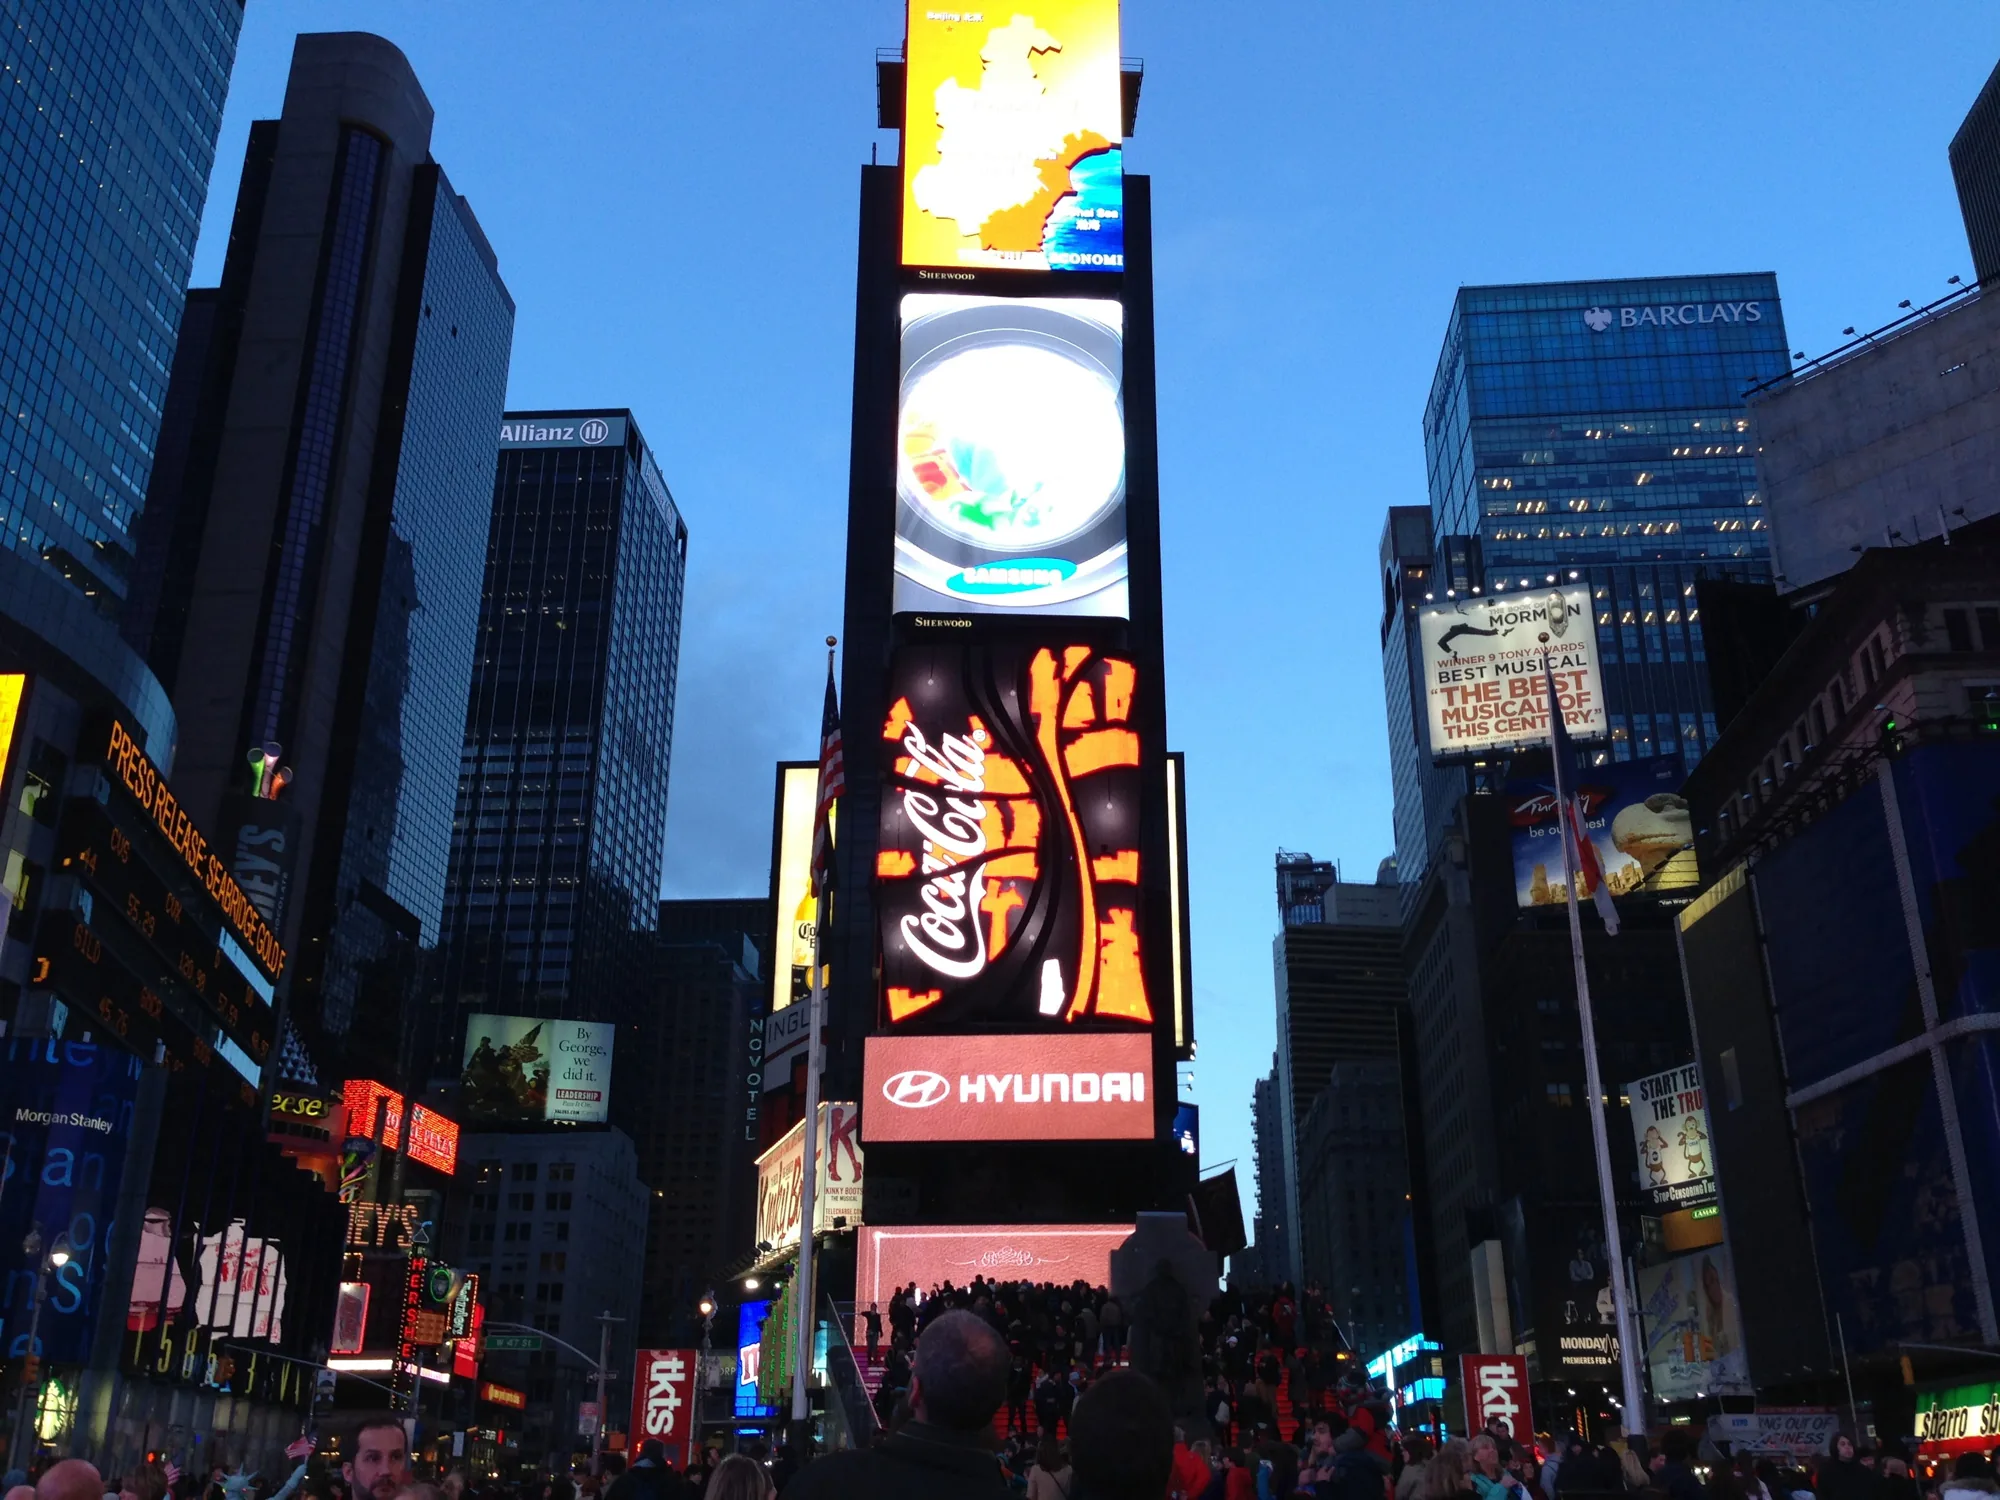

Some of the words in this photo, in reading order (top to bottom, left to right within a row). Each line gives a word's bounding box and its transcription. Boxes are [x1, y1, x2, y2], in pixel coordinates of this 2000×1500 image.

[919, 269, 976, 281] SHERWOOD
[1620, 302, 1761, 328] BARCLAYS
[500, 424, 574, 441] Allianz
[962, 565, 1063, 586] SAMSUNG
[914, 616, 973, 629] SHERWOOD
[1437, 655, 1485, 668] WINNER
[1488, 653, 1496, 662] 9
[1499, 649, 1533, 661] TONY
[1534, 642, 1585, 656] AWARDS
[1438, 666, 1487, 684] BEST
[1495, 654, 1587, 677] MUSICAL
[1508, 670, 1588, 700] BEST
[1441, 697, 1549, 725] MUSICAL
[1559, 692, 1592, 711] OF
[1443, 722, 1490, 740] THIS
[1493, 708, 1602, 734] CENTRY.”
[107, 719, 155, 810] PRESS
[153, 782, 207, 881] RELEASE:
[205, 854, 258, 946] SEABRIDGE
[1529, 825, 1545, 838] be
[1548, 827, 1563, 836] ou
[901, 720, 986, 979] Coca-Cola
[576, 1027, 593, 1040] By
[559, 1040, 607, 1056] George,
[573, 1057, 591, 1067] we
[563, 1068, 583, 1080] did
[585, 1070, 597, 1081] it.
[744, 1018, 764, 1141] NOVOTEL
[1640, 1069, 1679, 1101] START
[557, 1090, 599, 1100] LEADERSHIP
[959, 1071, 1145, 1103] HYUNDAI
[1652, 1096, 1676, 1121] THE
[15, 1108, 68, 1126] Morgan
[69, 1112, 114, 1135] Stanley
[825, 1187, 844, 1195] KINKY
[844, 1187, 864, 1195] BOOTS
[1693, 1207, 1718, 1219] LAMAR
[1560, 1336, 1606, 1350] MONDAY
[1562, 1356, 1595, 1364] PREMIERES
[1595, 1356, 1606, 1364] FEB
[1607, 1356, 1612, 1364] 4
[646, 1357, 686, 1436] tkts
[1785, 1416, 1810, 1430] OUT
[1811, 1416, 1833, 1430] OF
[1922, 1402, 1968, 1441] sbarro
